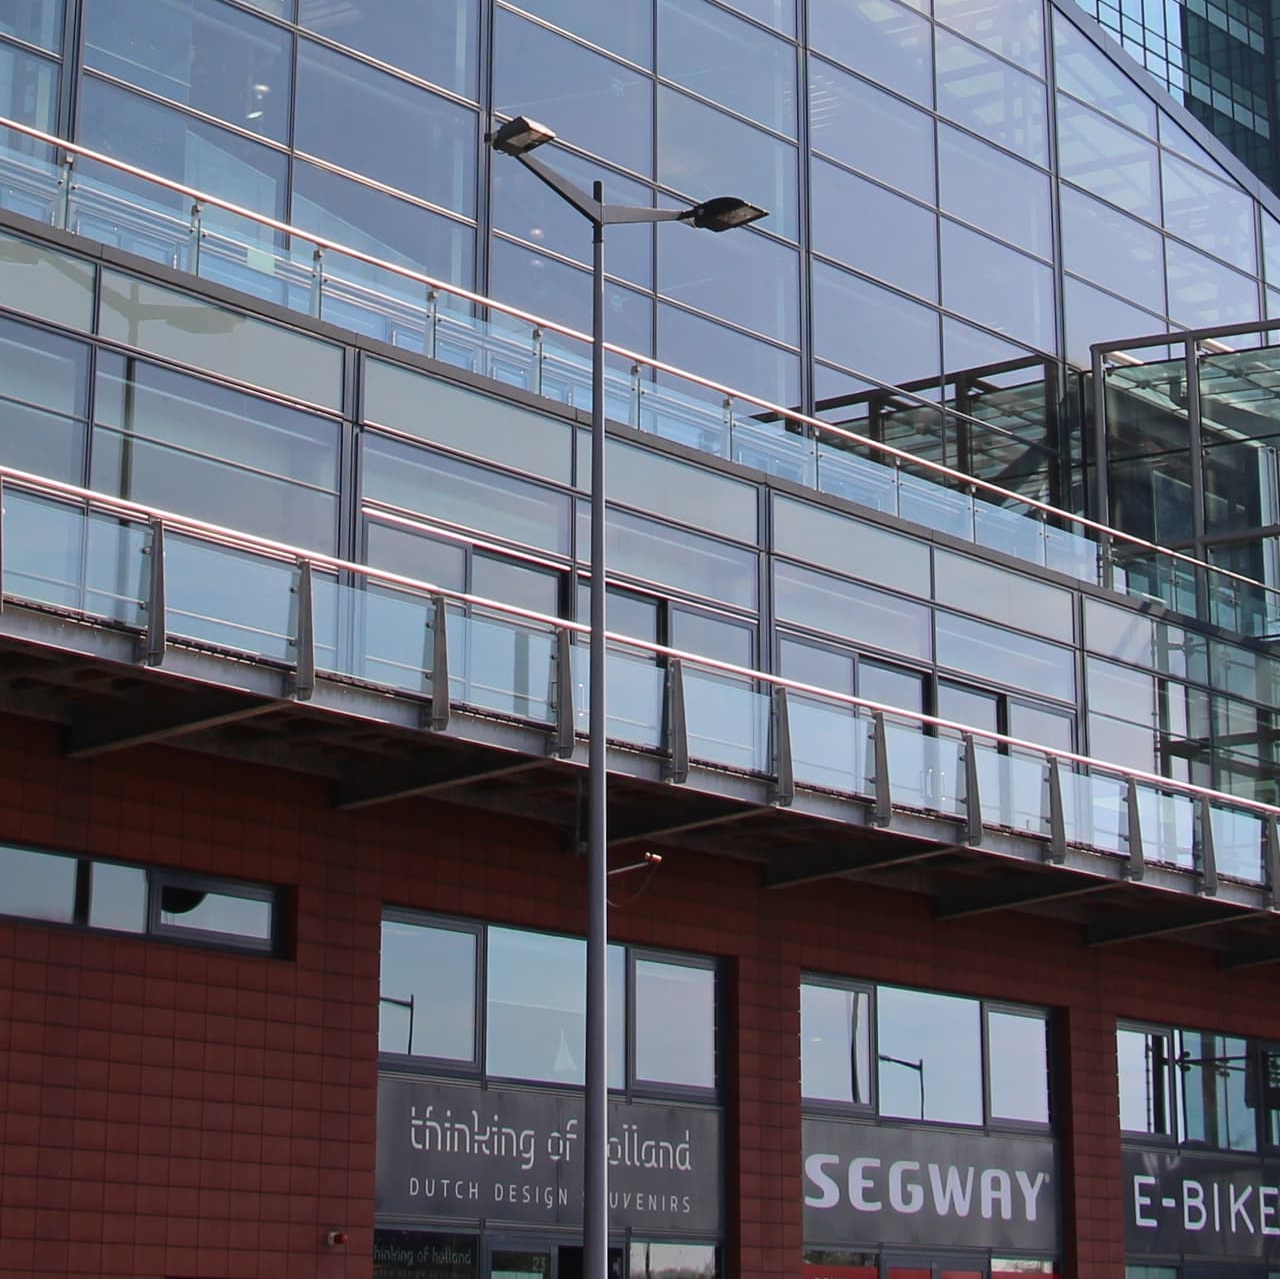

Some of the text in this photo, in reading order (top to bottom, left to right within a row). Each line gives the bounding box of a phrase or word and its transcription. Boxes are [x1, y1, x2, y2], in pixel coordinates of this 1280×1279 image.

[410, 1105, 692, 1171] thinking of olland
[409, 1177, 691, 1214] DUTCH DESIGN UVENIRS
[804, 1152, 1046, 1222] SEGWAY
